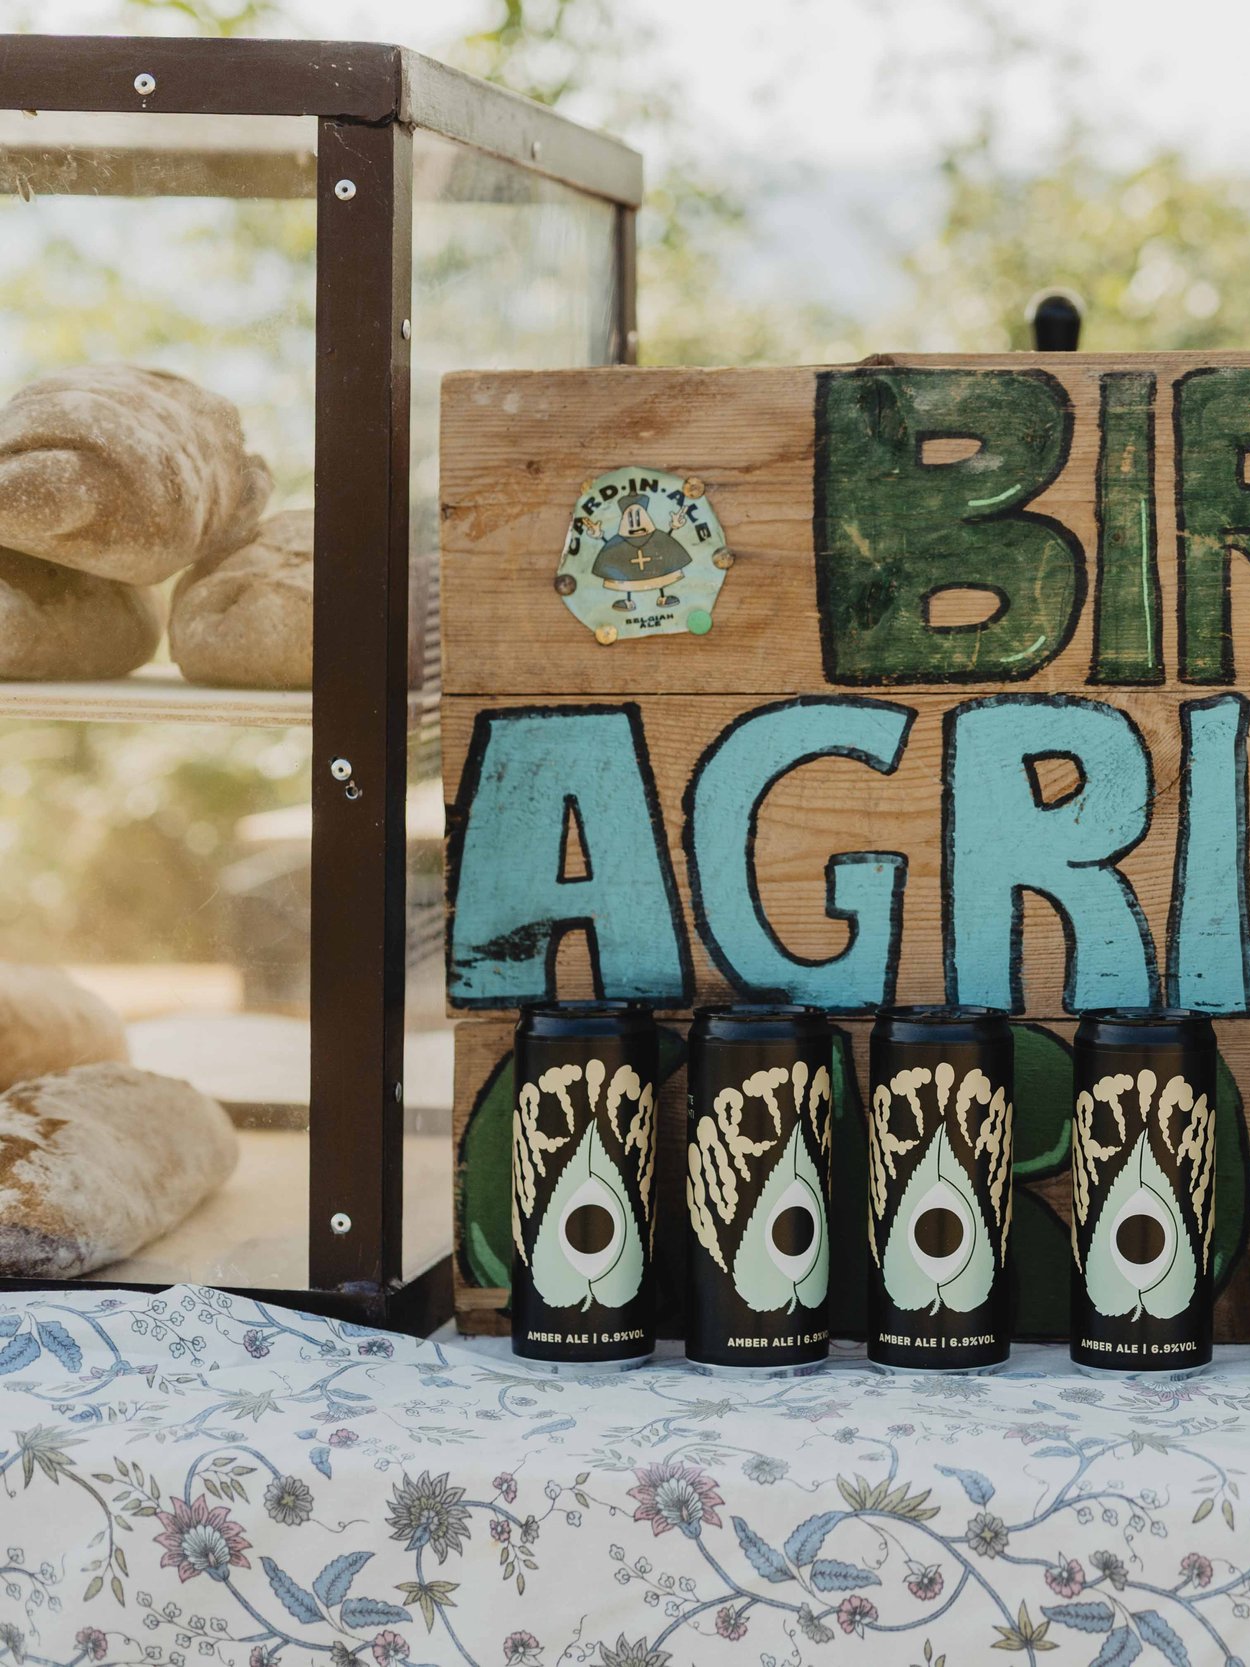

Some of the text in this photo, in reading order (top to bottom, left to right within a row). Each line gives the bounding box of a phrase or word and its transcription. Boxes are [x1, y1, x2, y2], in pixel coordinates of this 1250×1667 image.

[625, 613, 674, 625] BELGIAN
[639, 621, 662, 629] ALE
[527, 1329, 644, 1344] AMBER ALE 6.9%VOL
[728, 1336, 768, 1348] AMBER
[772, 1336, 794, 1346] ALE
[879, 1333, 995, 1348] AMBER ALE 6.9%VOL
[1081, 1338, 1197, 1354] AMBER ALE 6.9%VOL
